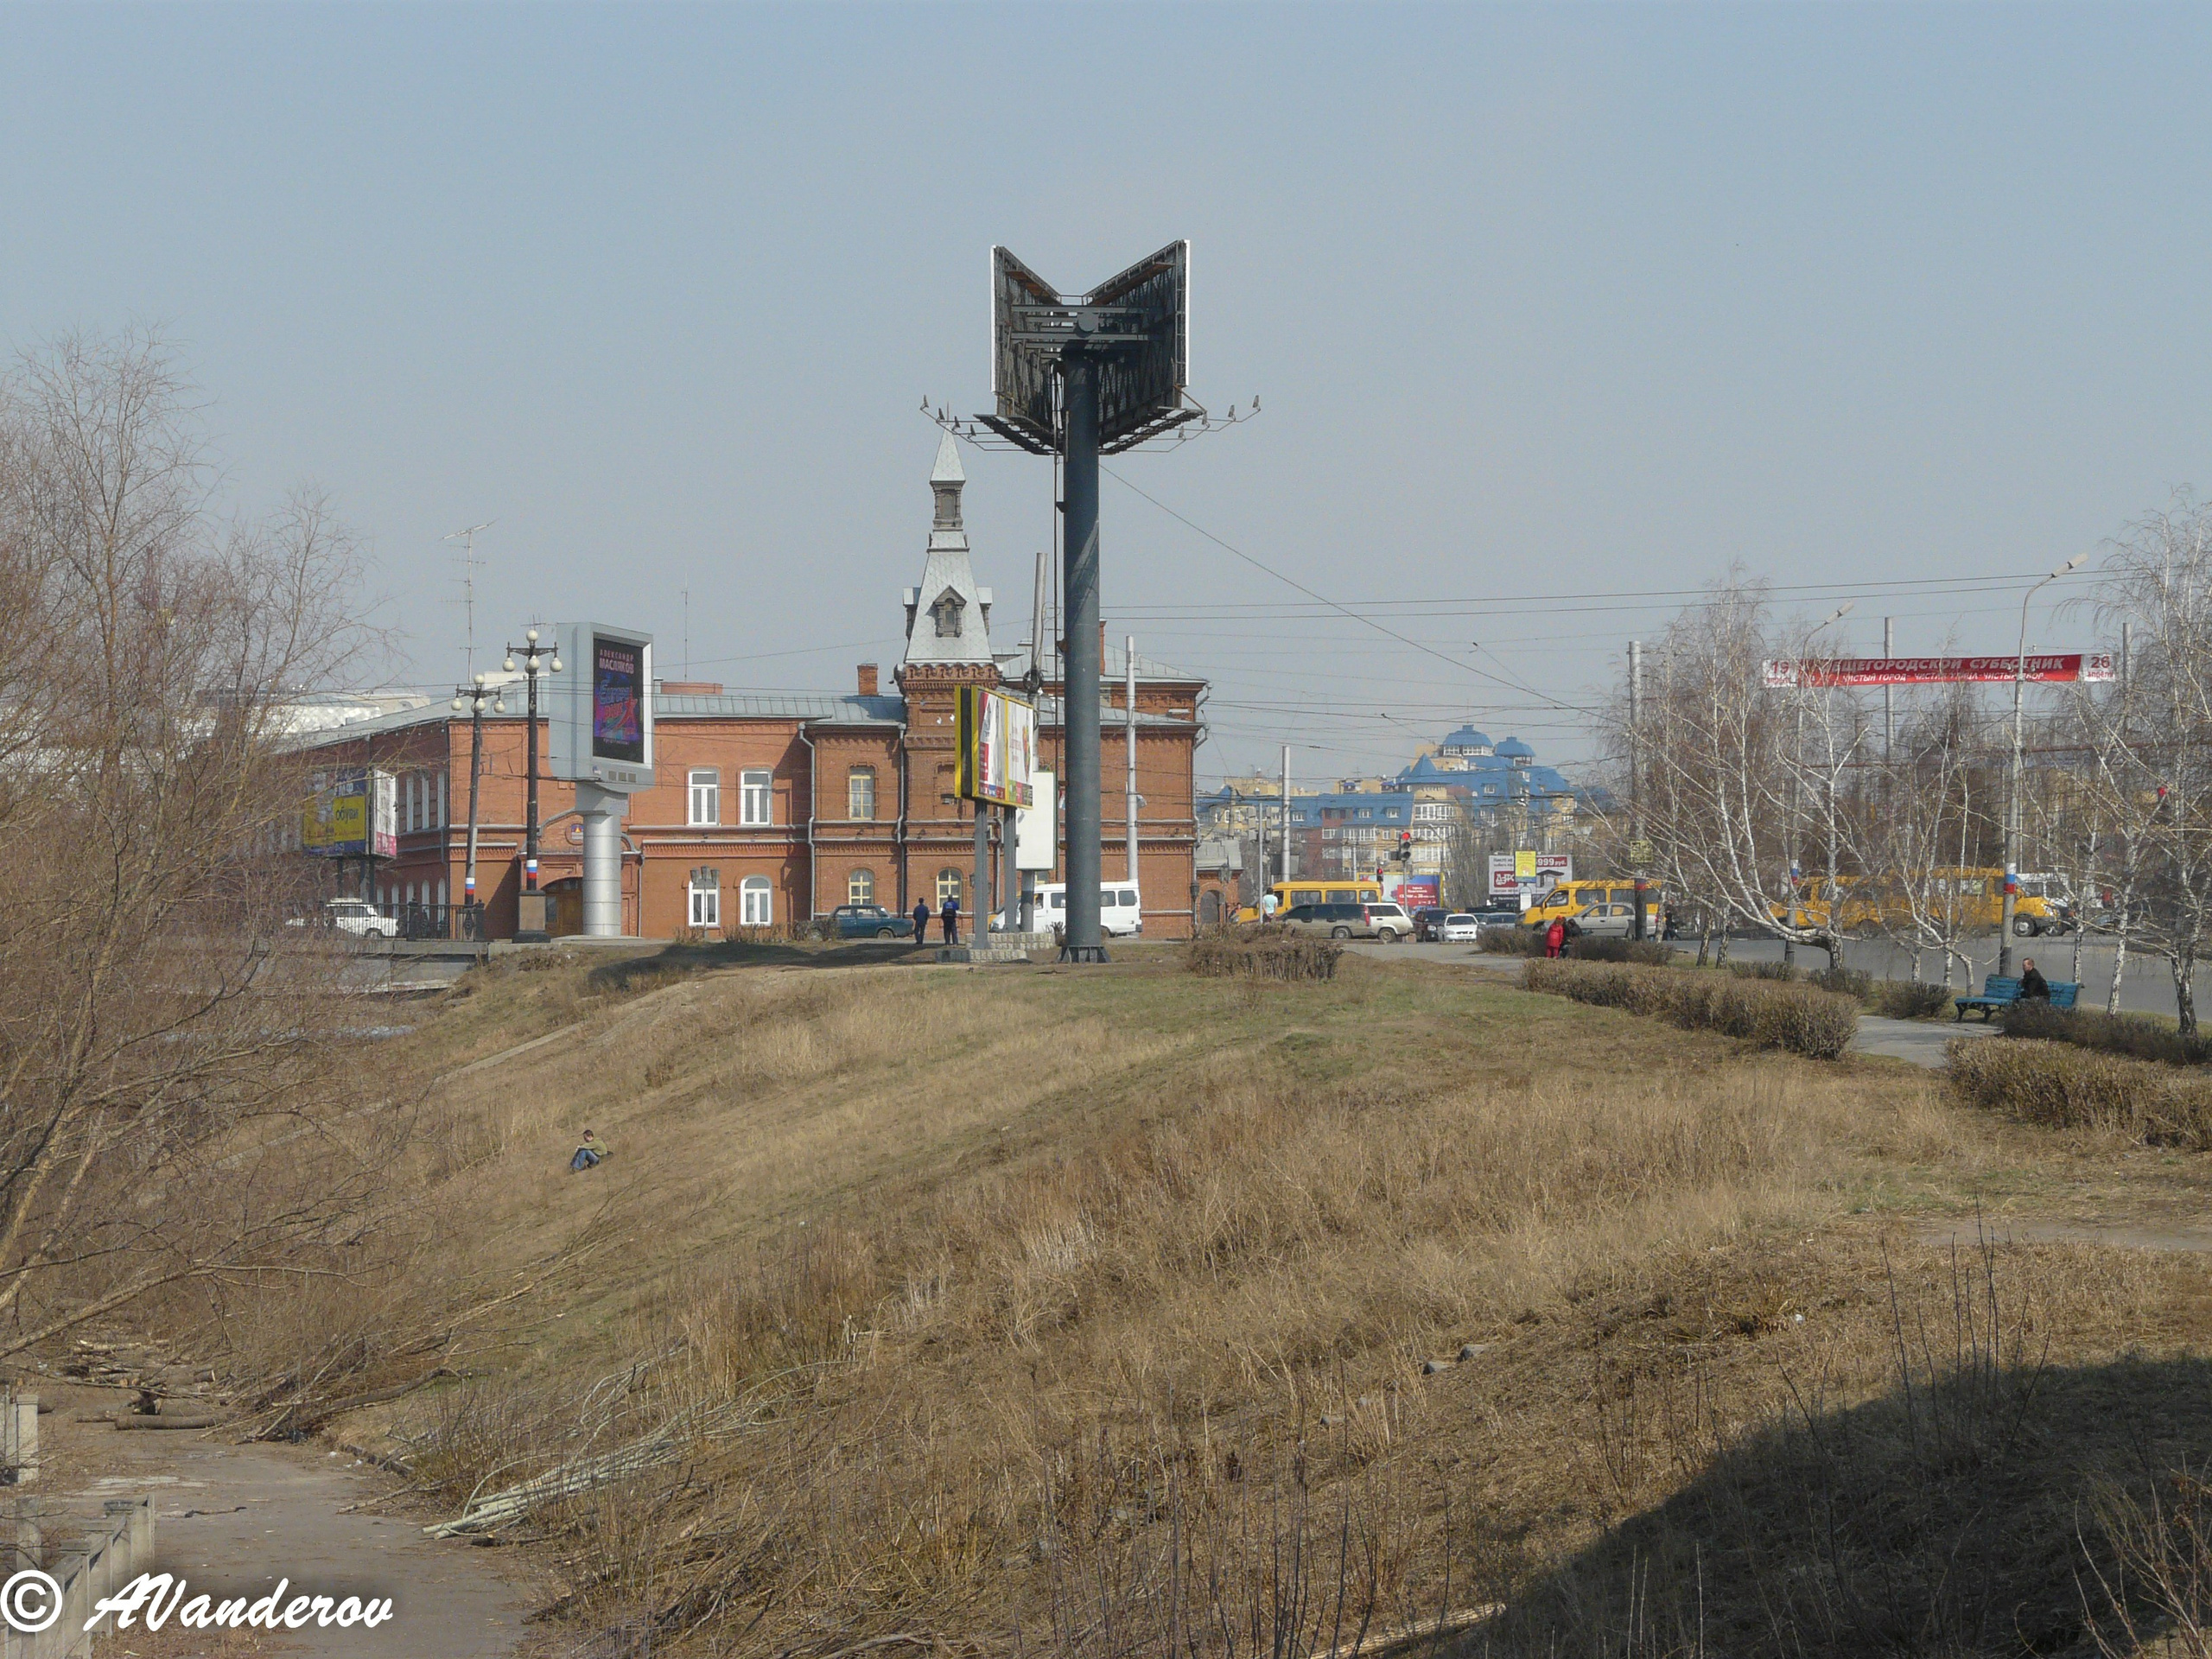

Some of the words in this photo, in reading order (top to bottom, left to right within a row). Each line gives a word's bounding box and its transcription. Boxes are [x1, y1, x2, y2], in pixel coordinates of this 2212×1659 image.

[600, 649, 634, 661] АЛЕКСАНДР
[599, 658, 635, 674] МАСЛЯКОВ
[1771, 660, 1789, 674] 19
[1822, 658, 1962, 673] БЩЕГОРОДСКОЙ
[1969, 657, 2065, 670] СУББОТНИК
[2090, 656, 2110, 668] 26
[1842, 672, 1877, 682] ЧИСТЫЙ
[1878, 672, 1906, 681] ГОРОД
